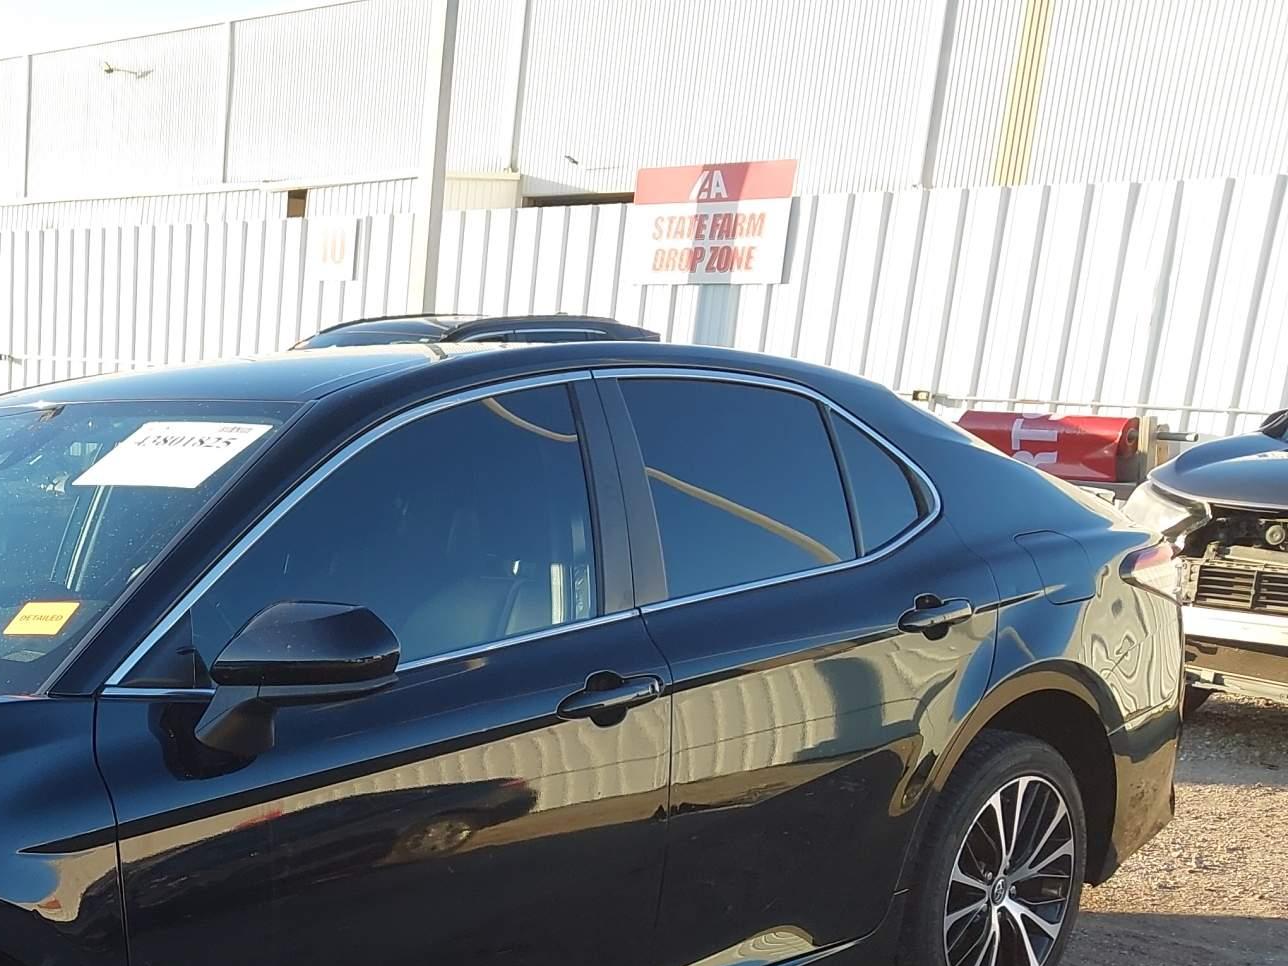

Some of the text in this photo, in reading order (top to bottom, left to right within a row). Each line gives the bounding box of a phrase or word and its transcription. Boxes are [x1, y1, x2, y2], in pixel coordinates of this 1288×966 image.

[652, 212, 767, 240] STATE FARM
[652, 245, 756, 273] DROP ZONE
[19, 614, 64, 622] DETAILED
